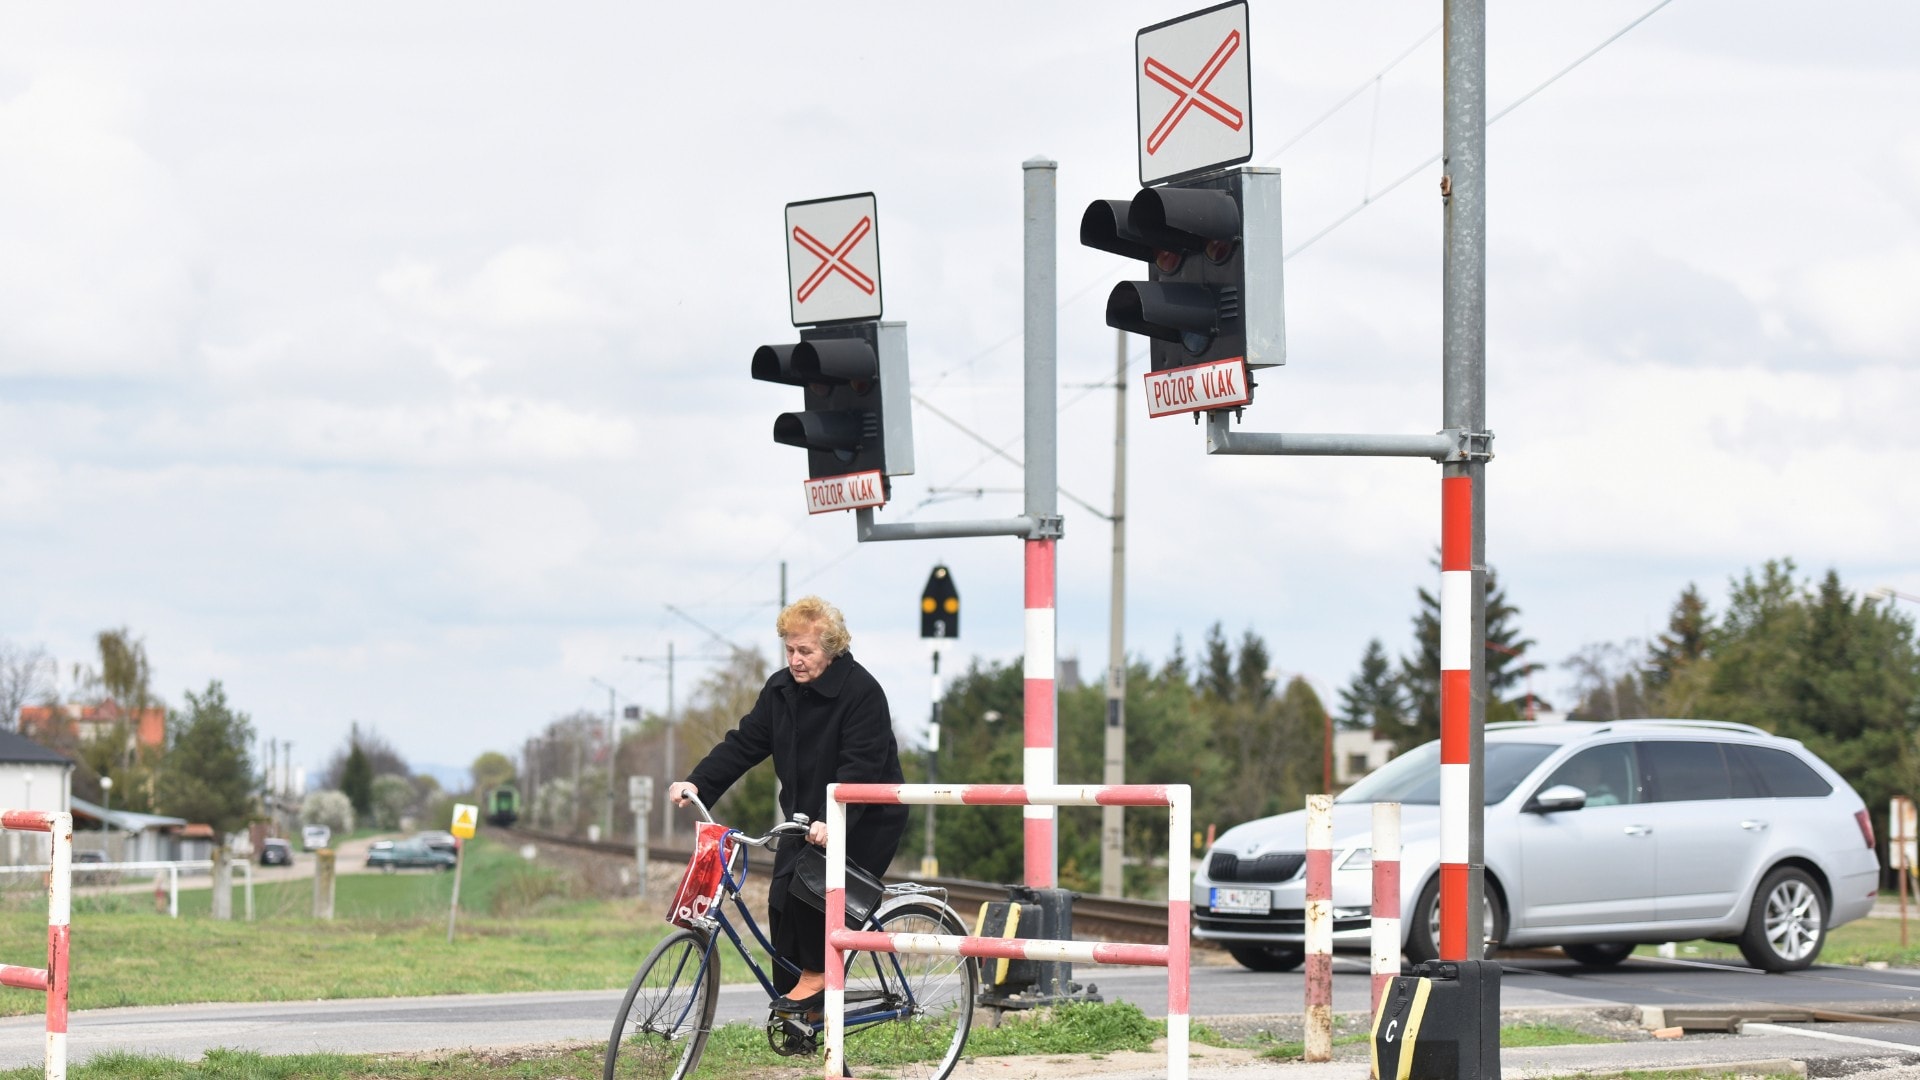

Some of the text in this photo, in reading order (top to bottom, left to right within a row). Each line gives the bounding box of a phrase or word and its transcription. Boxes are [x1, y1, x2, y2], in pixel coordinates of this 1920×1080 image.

[1153, 368, 1236, 408] POZOR VLAK
[811, 478, 875, 507] POZOR VLAK
[1385, 1019, 1398, 1043] C
